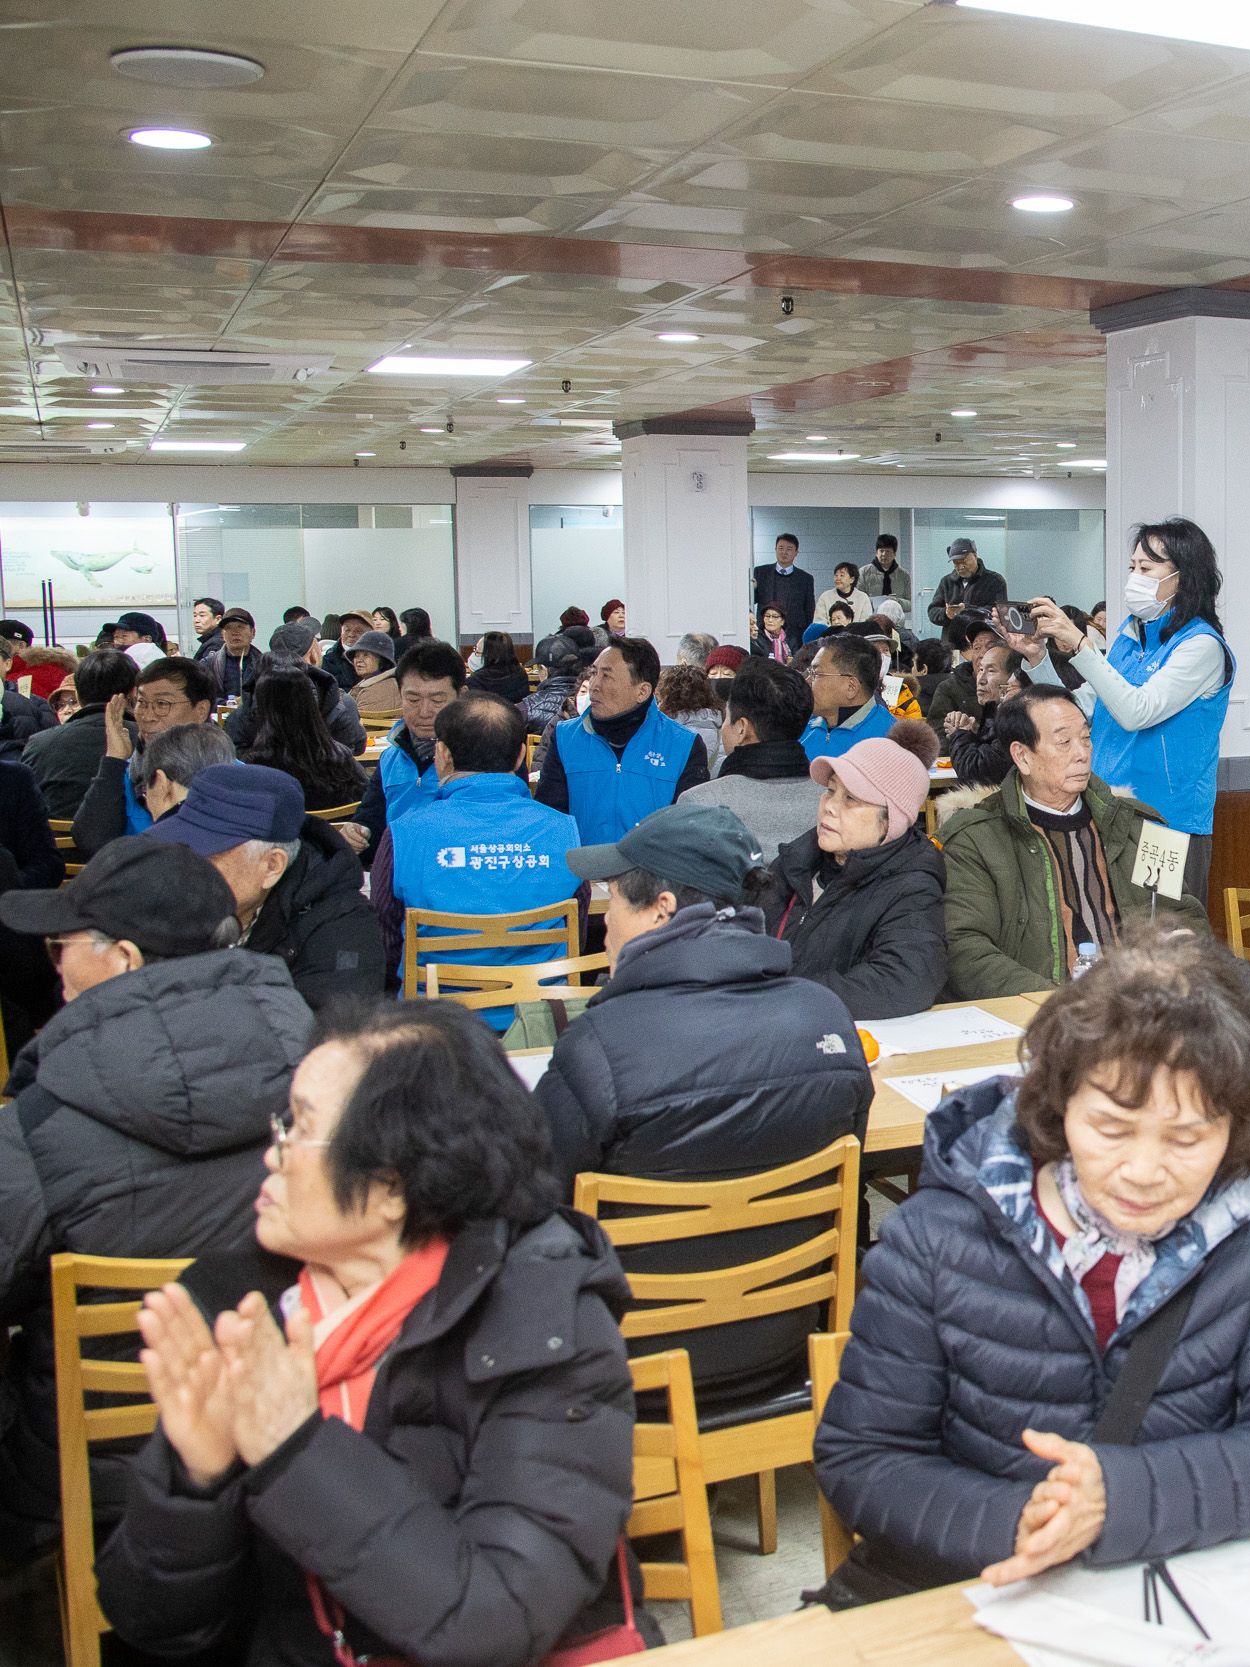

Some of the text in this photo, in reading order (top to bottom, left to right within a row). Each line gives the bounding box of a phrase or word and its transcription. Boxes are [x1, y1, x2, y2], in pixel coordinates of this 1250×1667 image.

[470, 843, 532, 854] 서울상공회의소
[1141, 840, 1179, 872] 중곡4동
[469, 854, 550, 870] 광진구상공회
